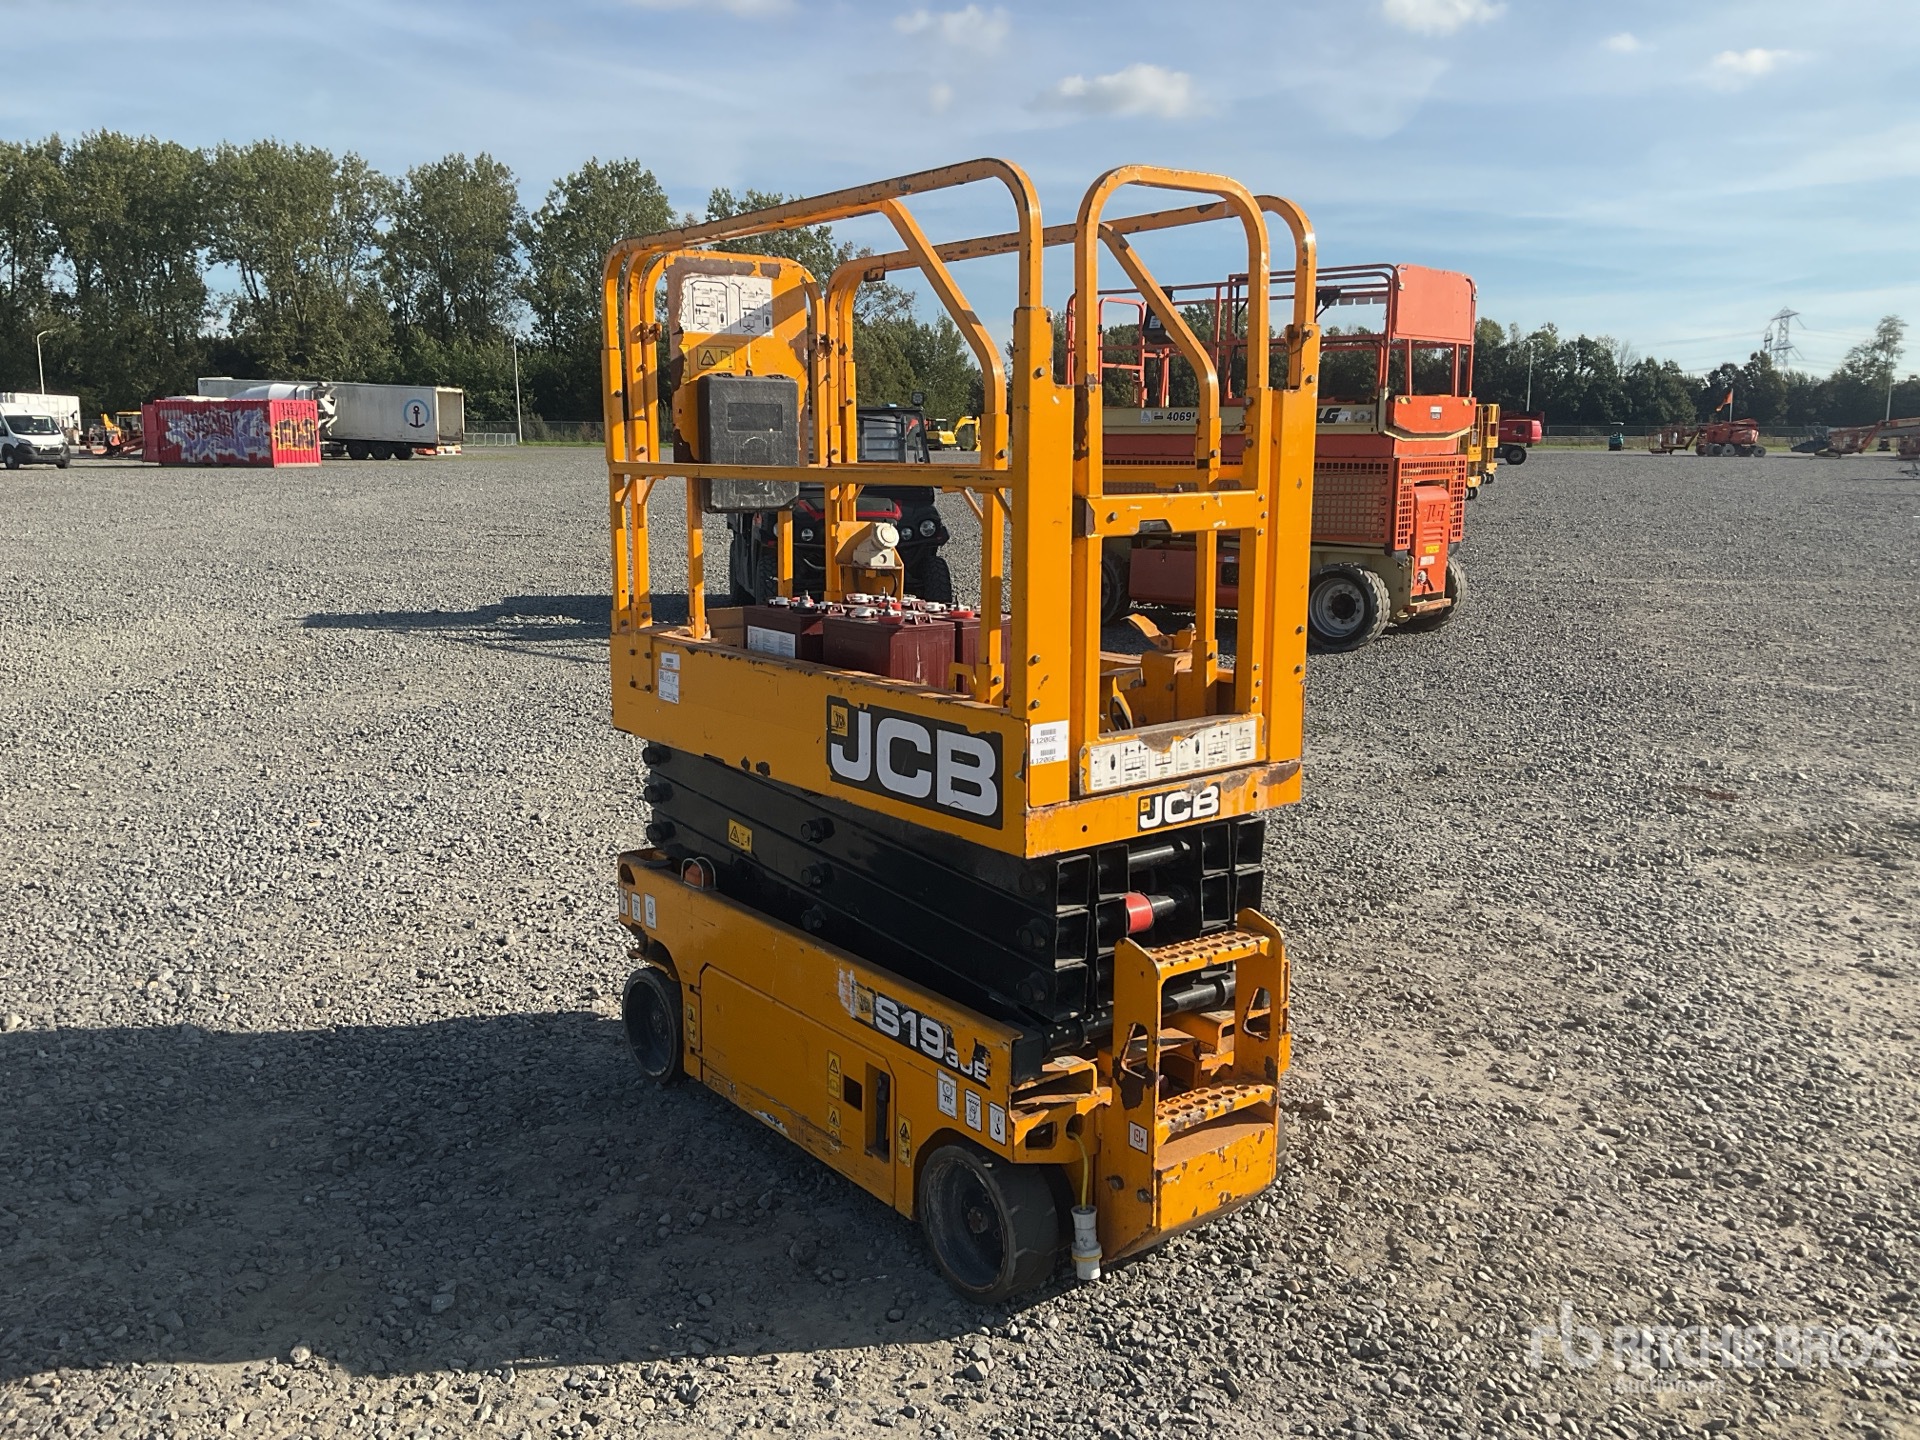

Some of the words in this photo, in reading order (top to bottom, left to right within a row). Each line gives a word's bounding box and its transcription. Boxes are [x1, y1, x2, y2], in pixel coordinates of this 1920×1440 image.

[1317, 408, 1341, 423] LG
[831, 711, 998, 816] JCB
[1140, 786, 1219, 829] JCB
